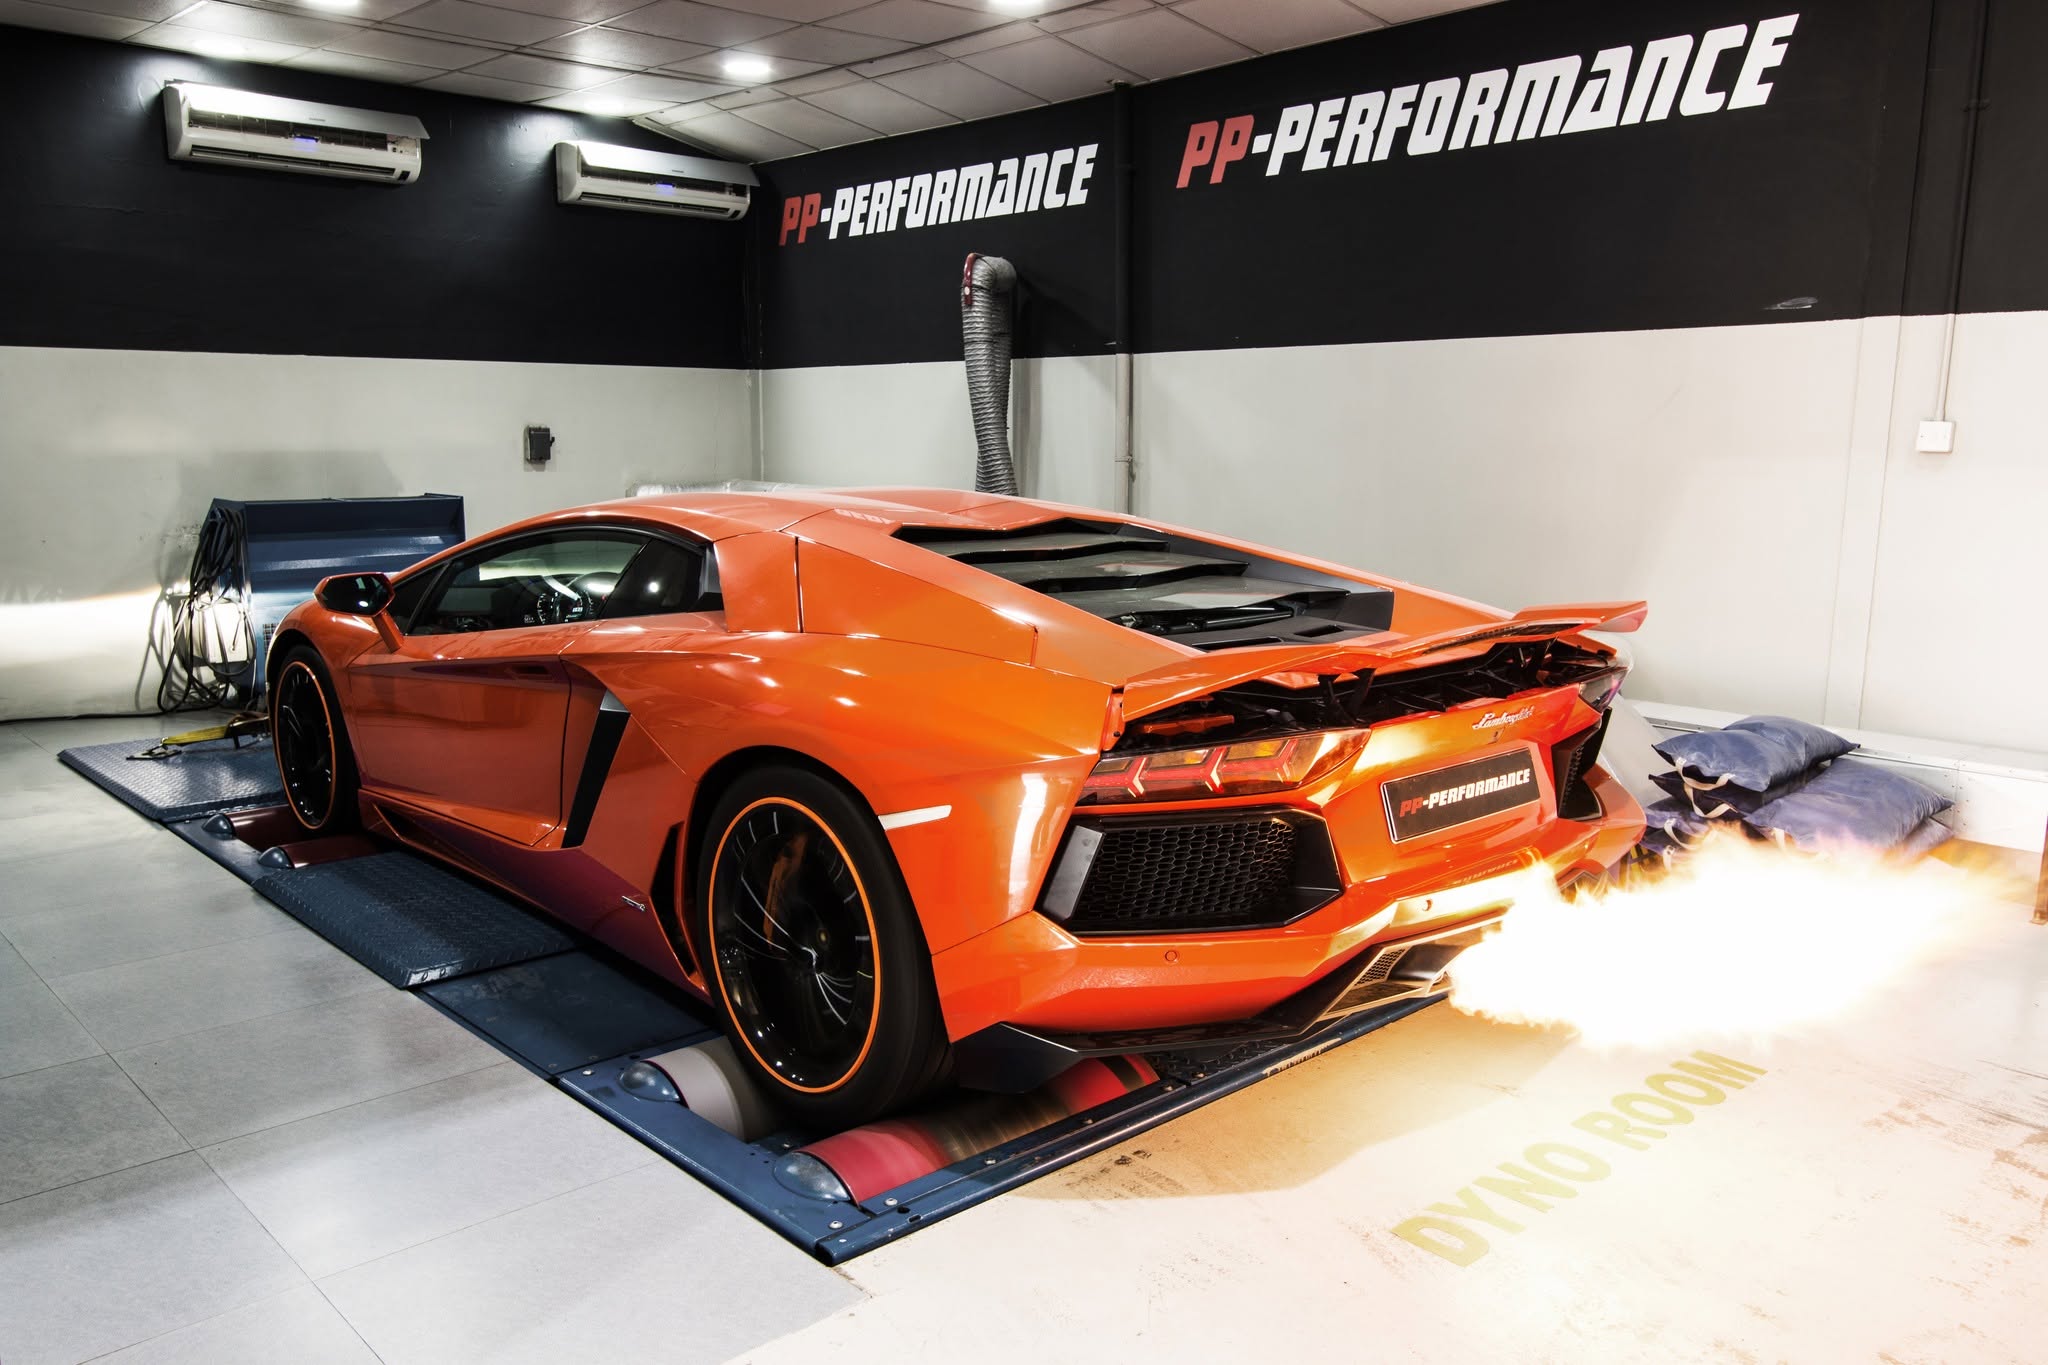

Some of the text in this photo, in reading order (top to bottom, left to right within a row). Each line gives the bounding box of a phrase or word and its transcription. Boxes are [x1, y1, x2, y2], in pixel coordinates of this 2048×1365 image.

[1175, 13, 1800, 189] PP-PERFORMANCE
[779, 143, 1099, 246] PP-PERFORMANCE
[1471, 705, 1535, 730] Lamborg
[1399, 768, 1531, 818] PP-PERFORMANCE
[1390, 1050, 1768, 1267] DYNO ROOM
